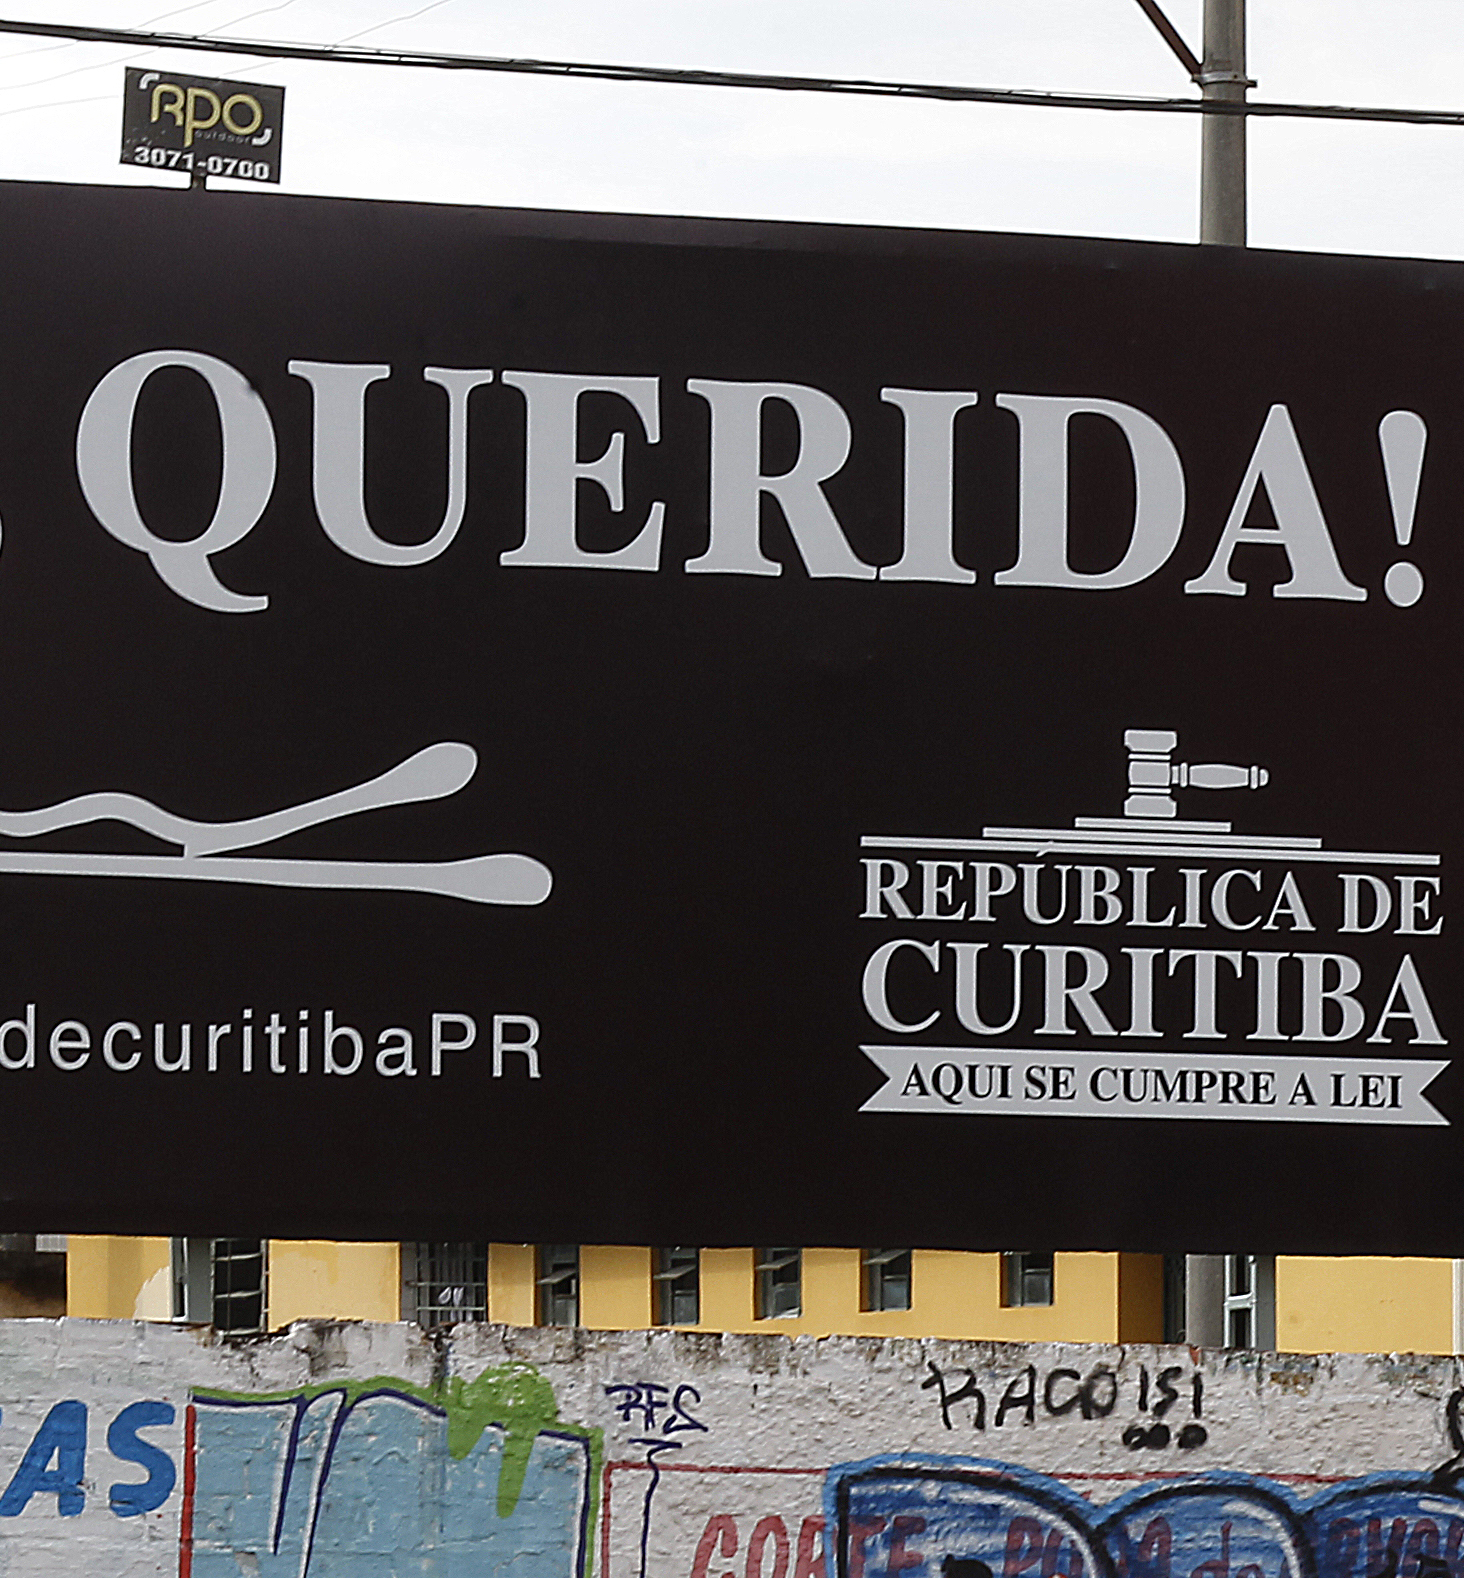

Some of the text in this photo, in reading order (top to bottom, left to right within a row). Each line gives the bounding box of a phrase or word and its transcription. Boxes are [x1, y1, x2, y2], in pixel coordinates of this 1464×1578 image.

[134, 146, 270, 180] 3071-0700
[77, 350, 1428, 612] QUERIDA!
[859, 841, 1444, 935] REPÚBLICA DE
[862, 939, 1449, 1045] CURITIBA
[901, 1063, 1403, 1109] AQUI SE CUMPRE A LEI
